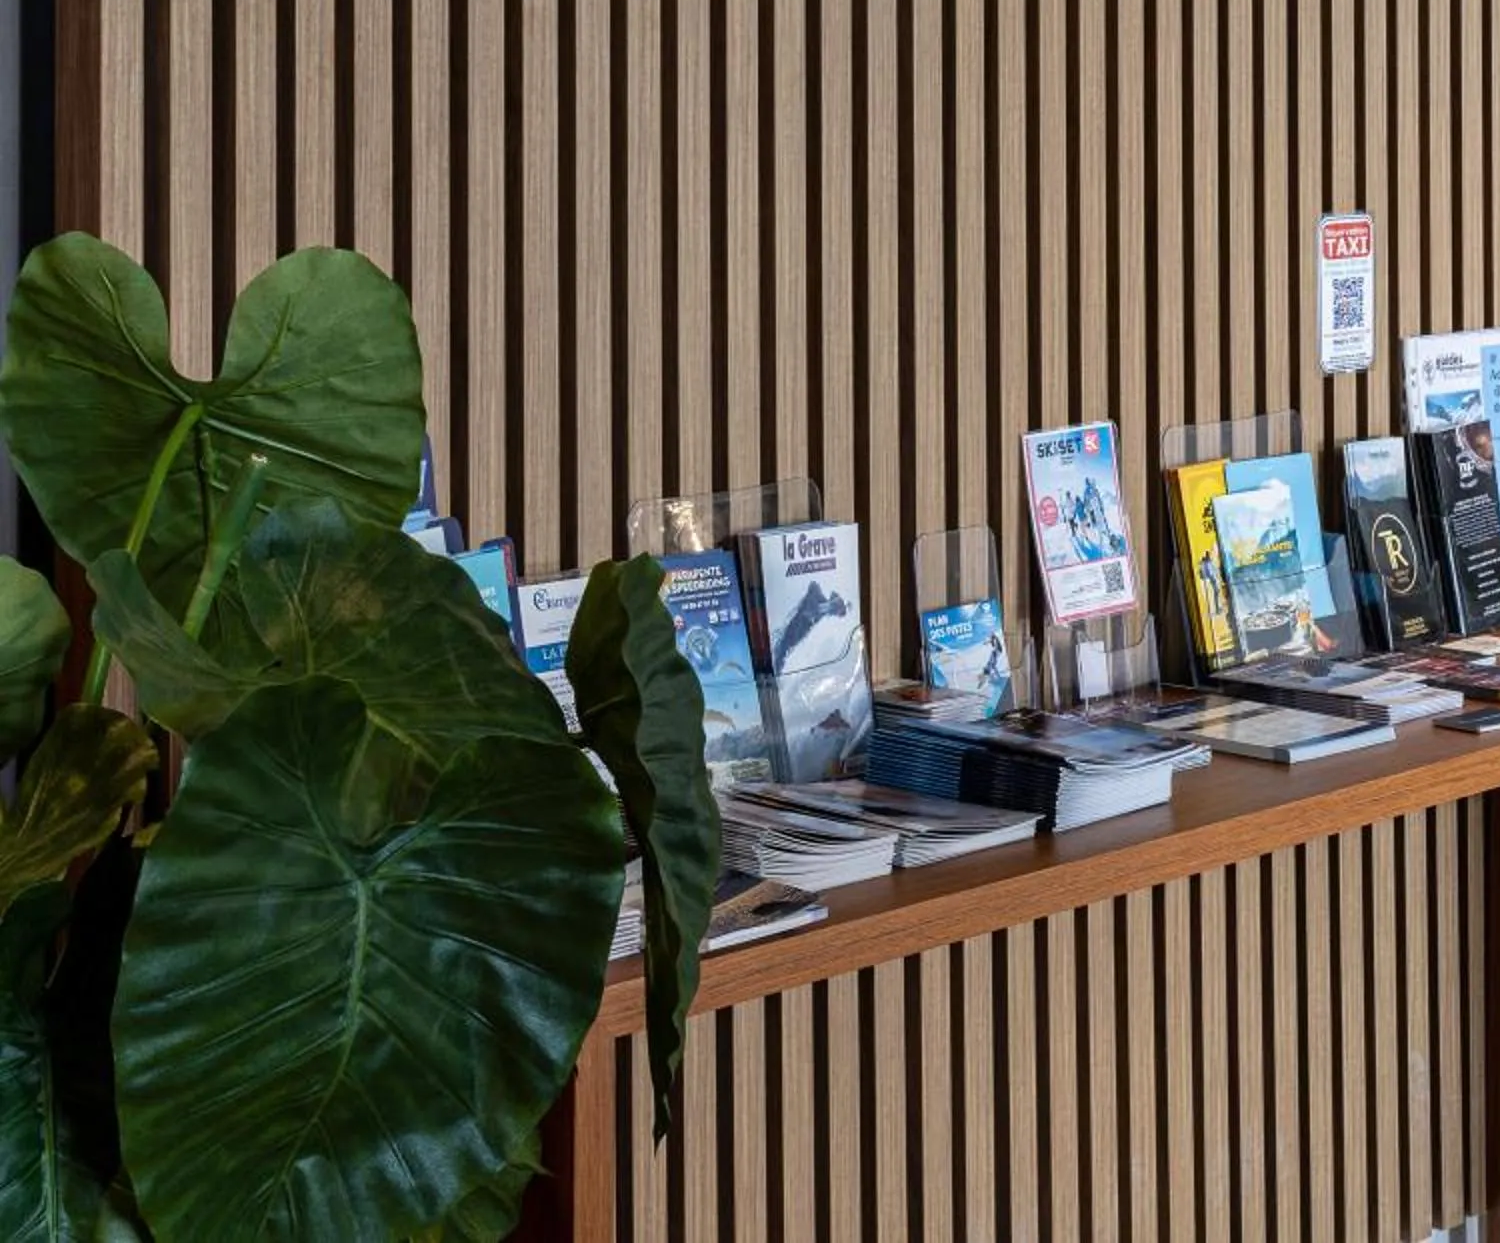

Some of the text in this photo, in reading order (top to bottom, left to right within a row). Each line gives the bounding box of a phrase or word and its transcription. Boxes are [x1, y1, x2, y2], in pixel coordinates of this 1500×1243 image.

[1325, 236, 1369, 257] TAXI
[783, 532, 836, 562] la Grave
